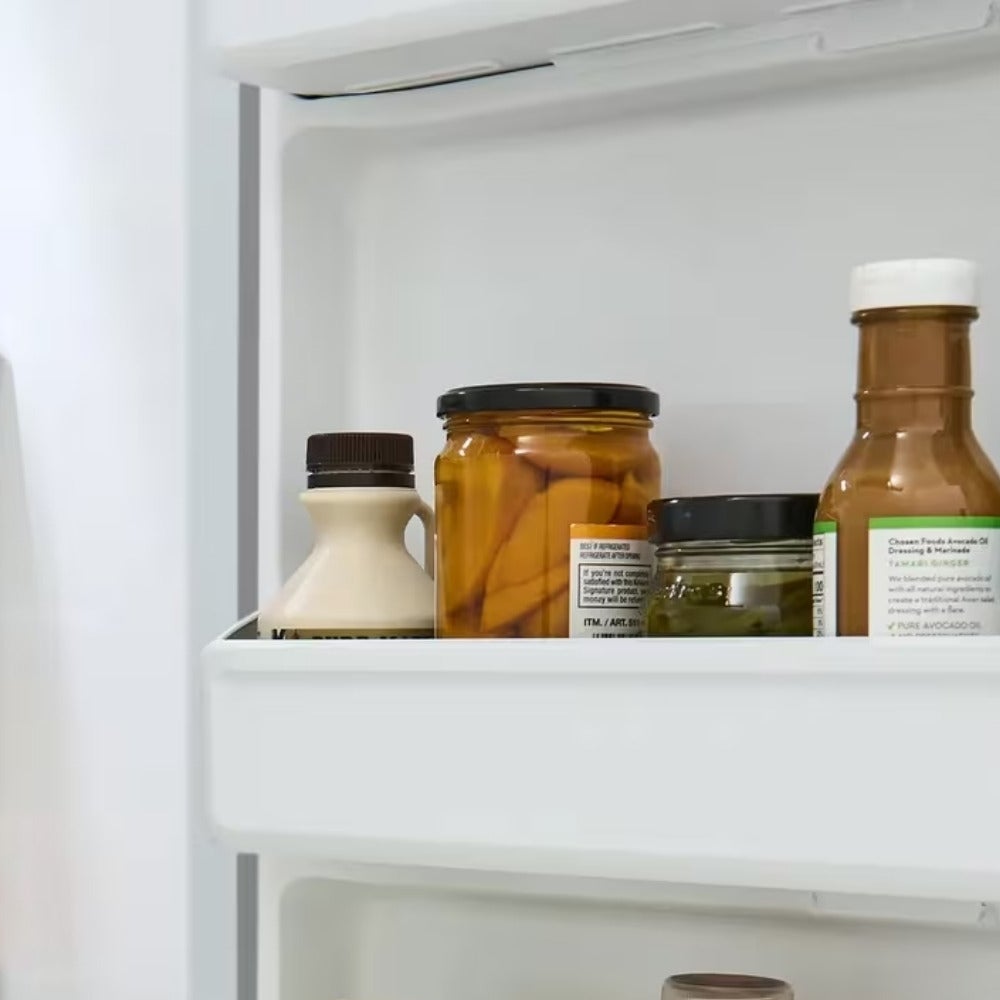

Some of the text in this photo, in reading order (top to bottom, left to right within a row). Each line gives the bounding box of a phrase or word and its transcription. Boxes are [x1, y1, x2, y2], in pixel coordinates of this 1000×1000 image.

[921, 537, 946, 545] Foods
[888, 547, 924, 555] Dressing
[934, 546, 970, 554] Marinade
[590, 569, 611, 578] you're
[903, 574, 935, 582] blended
[583, 586, 614, 595] Signature
[888, 607, 922, 616] dressing
[583, 618, 602, 627] ITM.
[609, 618, 628, 627] ART.
[897, 621, 919, 630] PURE
[923, 621, 967, 630] AVOCADO
